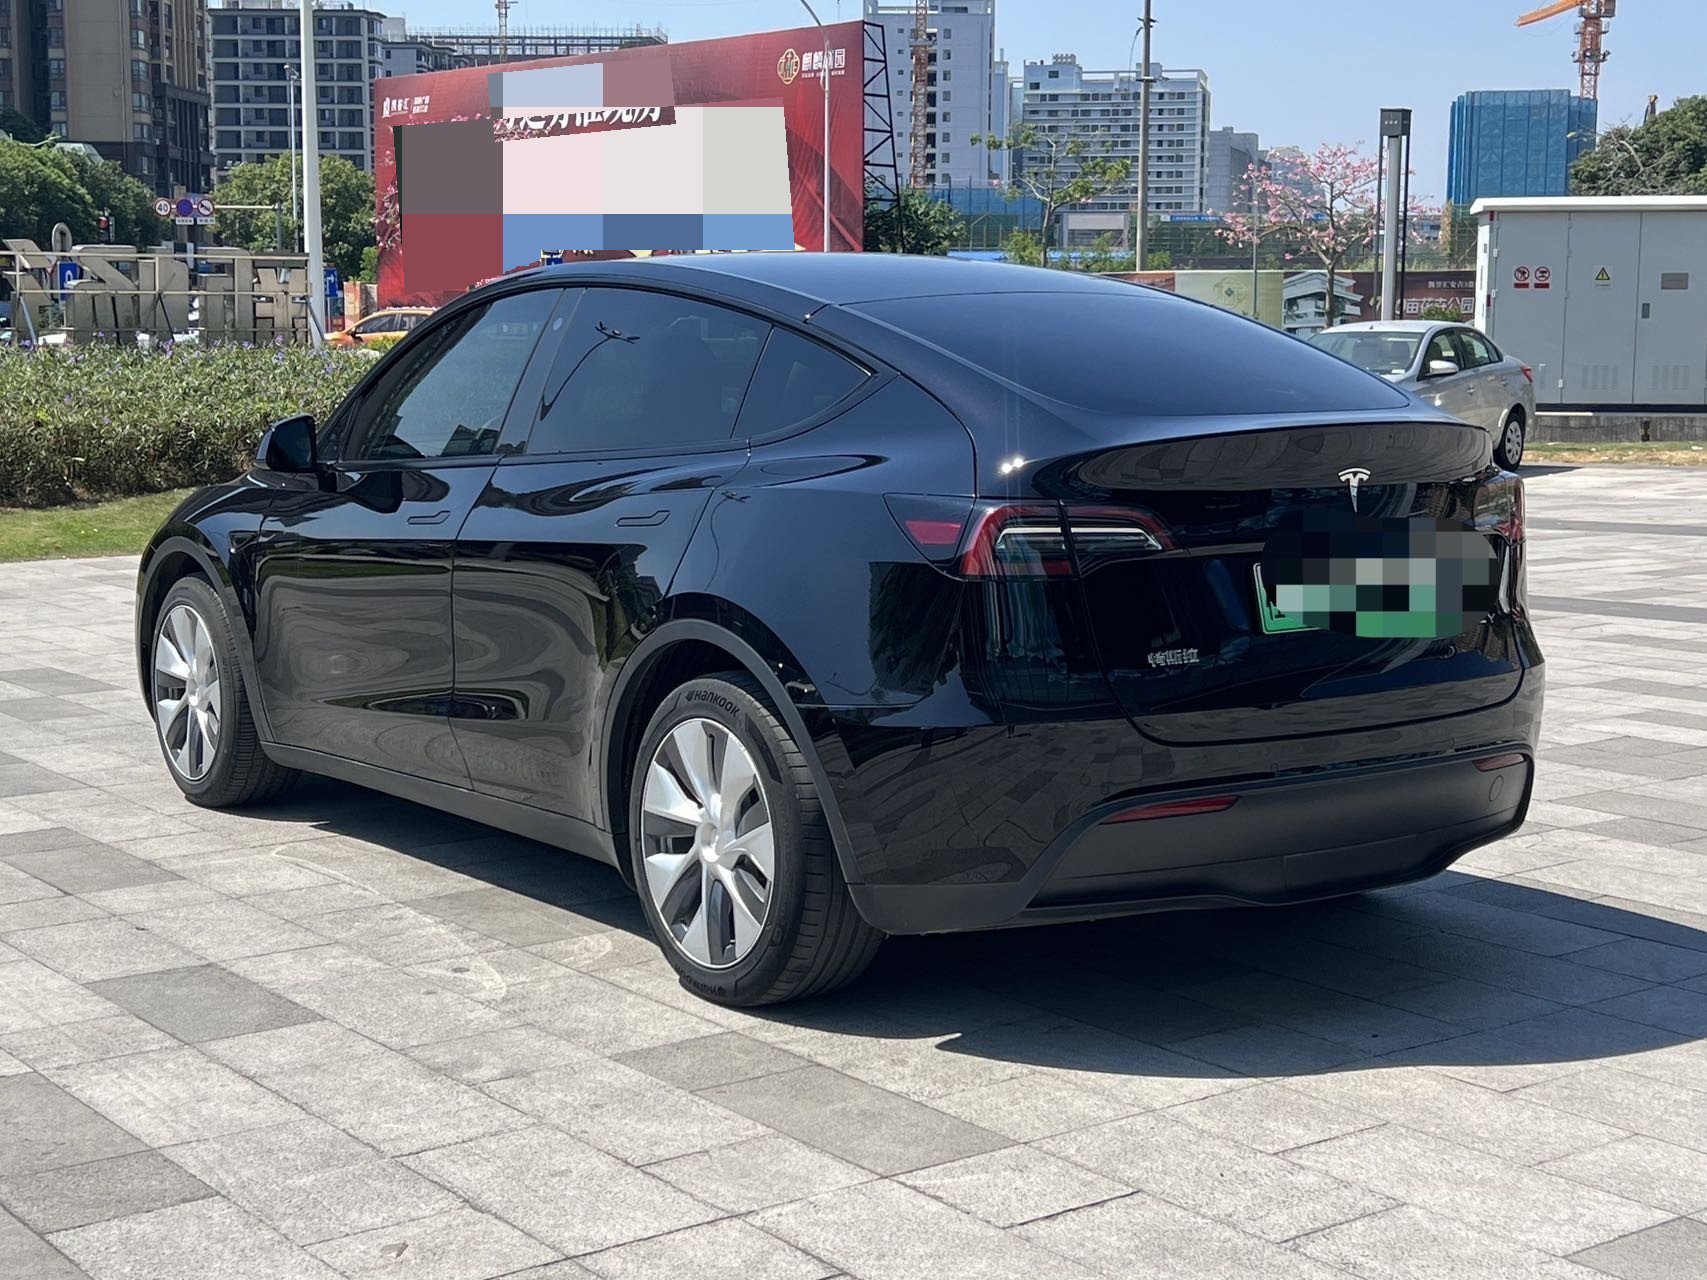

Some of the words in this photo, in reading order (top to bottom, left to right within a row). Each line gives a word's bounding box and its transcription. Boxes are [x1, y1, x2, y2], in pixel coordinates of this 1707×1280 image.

[157, 203, 169, 213] 40
[1147, 648, 1200, 668] 特斯拉
